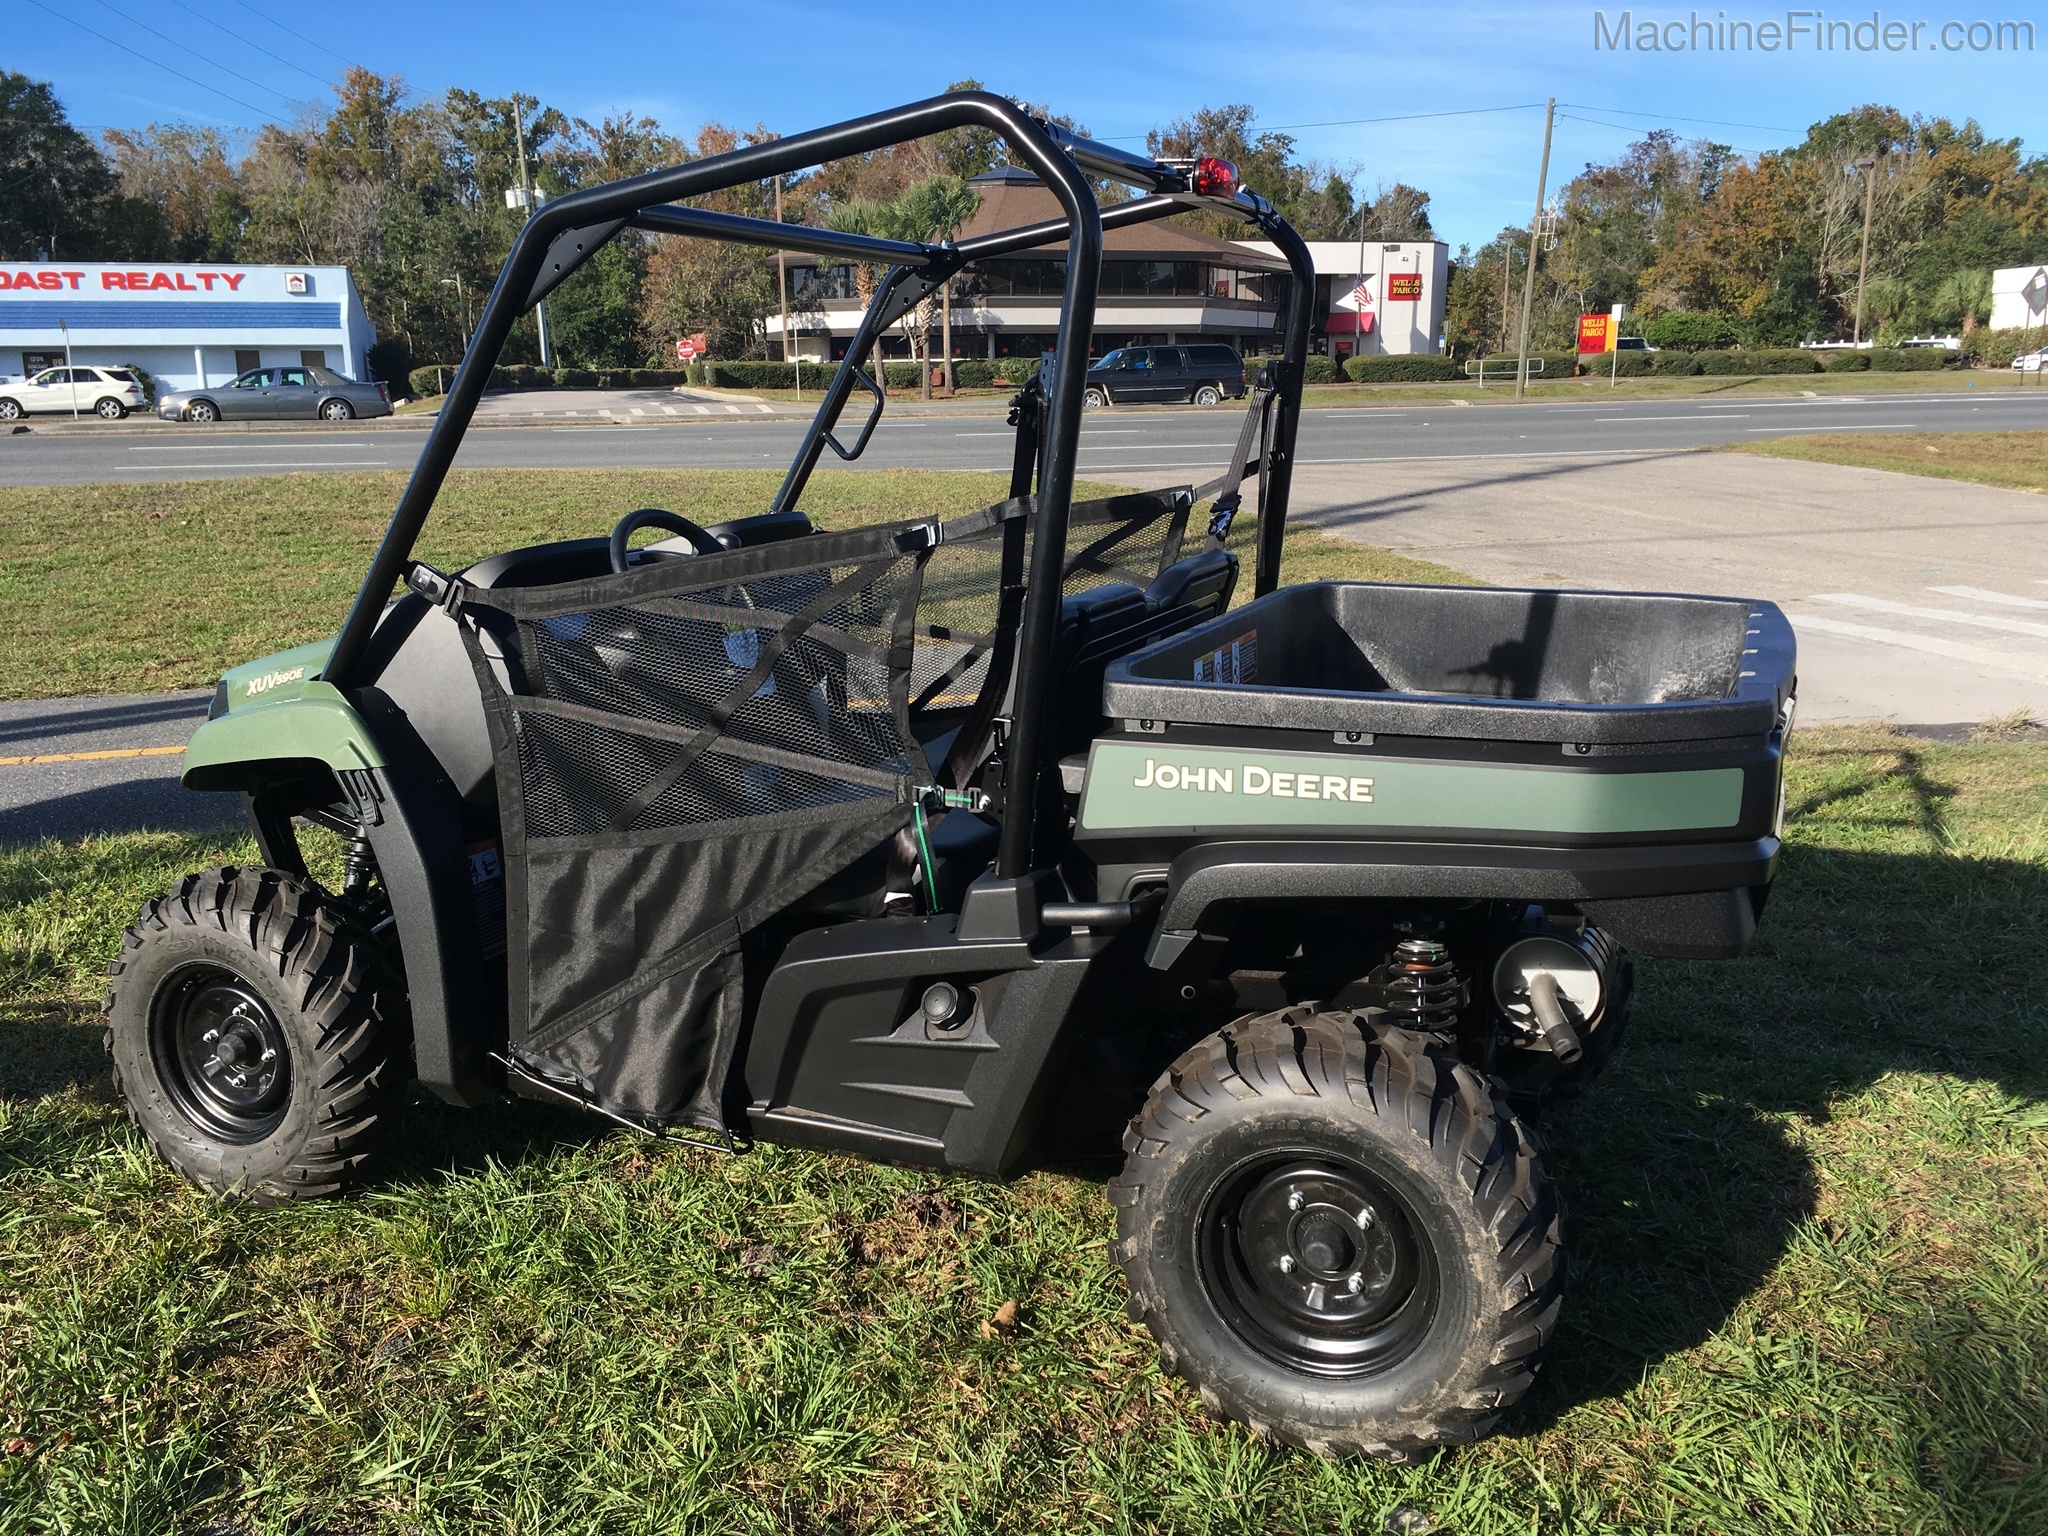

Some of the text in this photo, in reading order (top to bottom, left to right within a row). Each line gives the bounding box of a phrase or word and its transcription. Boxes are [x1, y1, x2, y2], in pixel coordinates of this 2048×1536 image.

[101, 272, 245, 291] REALTY
[1392, 279, 1420, 287] WELLS
[1582, 318, 1605, 328] WELLS
[1582, 327, 1605, 337] FARGO
[246, 668, 304, 697] XUV590E
[1134, 759, 1374, 803] JOHN DEERE
